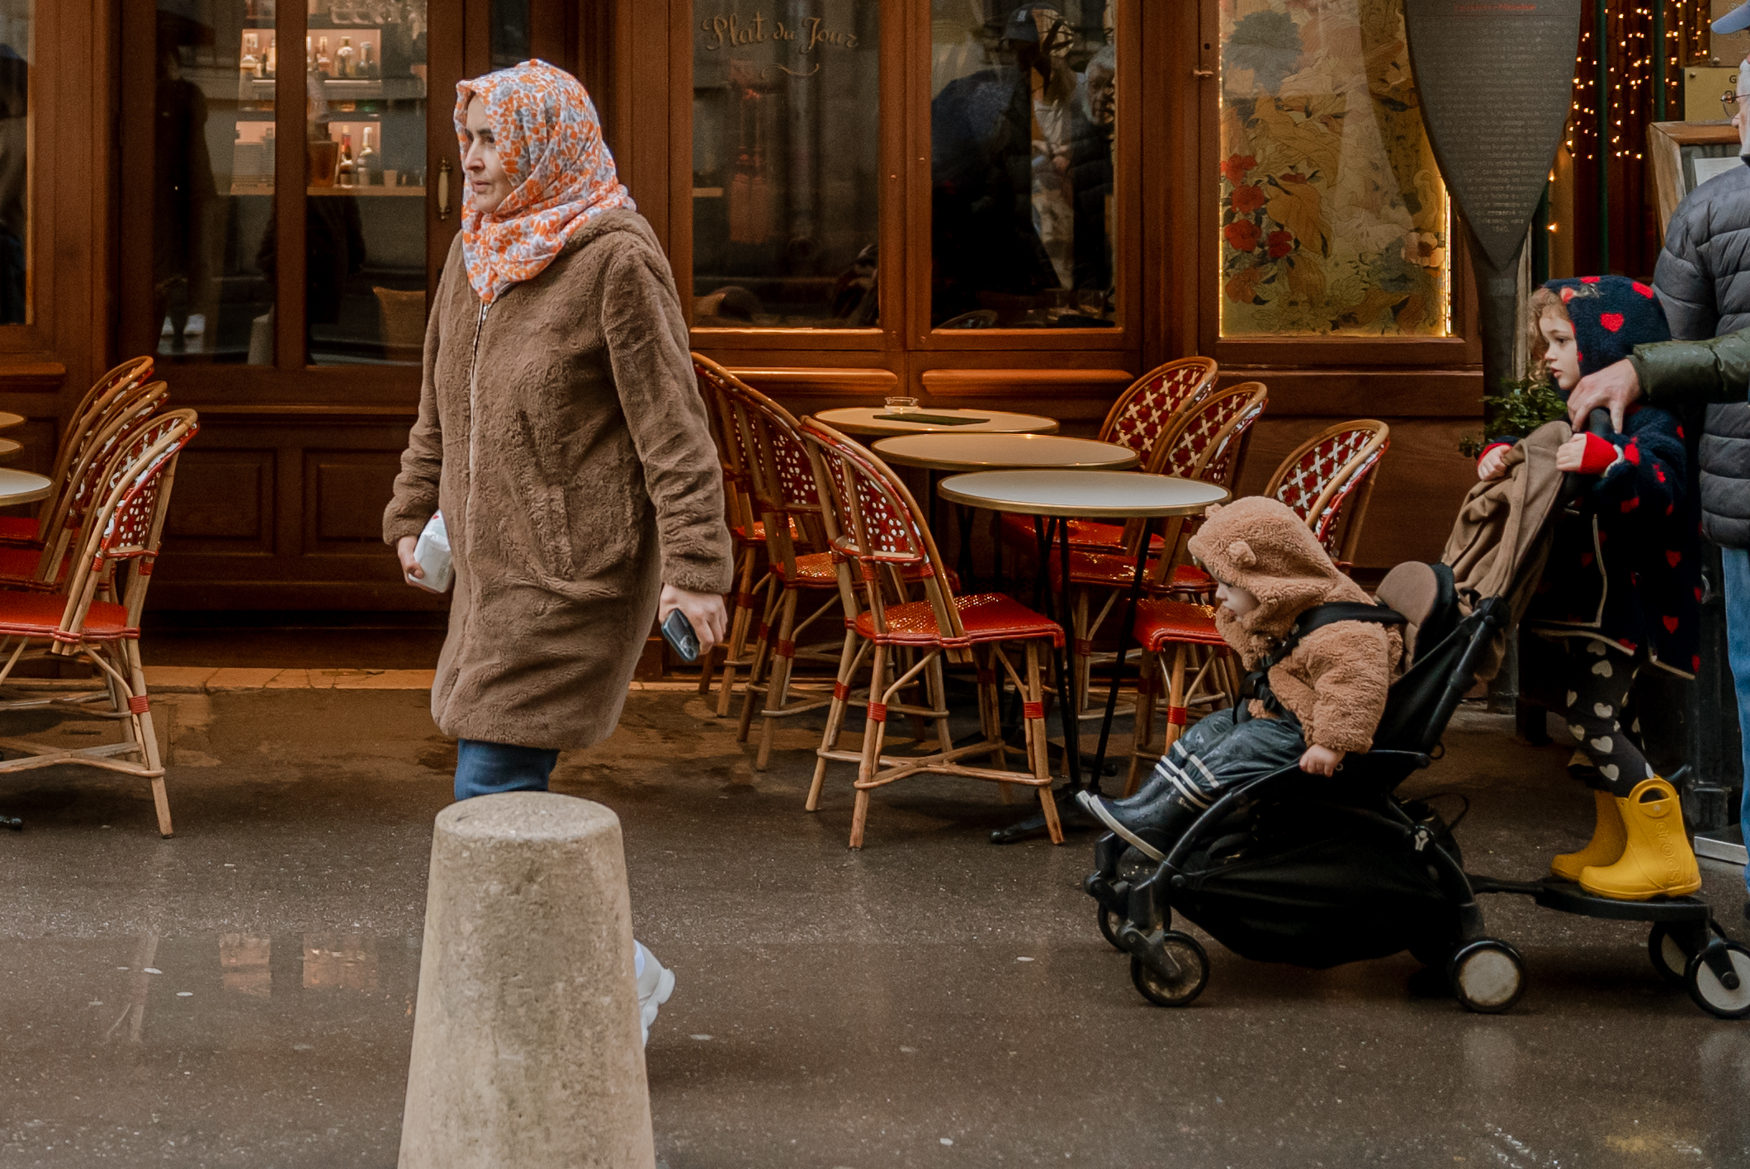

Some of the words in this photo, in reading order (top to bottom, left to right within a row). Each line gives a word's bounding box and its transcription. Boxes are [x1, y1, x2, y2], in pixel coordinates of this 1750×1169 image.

[702, 11, 767, 51] Plat
[772, 21, 797, 41] du
[801, 17, 858, 54] Jour
[1656, 820, 1681, 883] crocs
